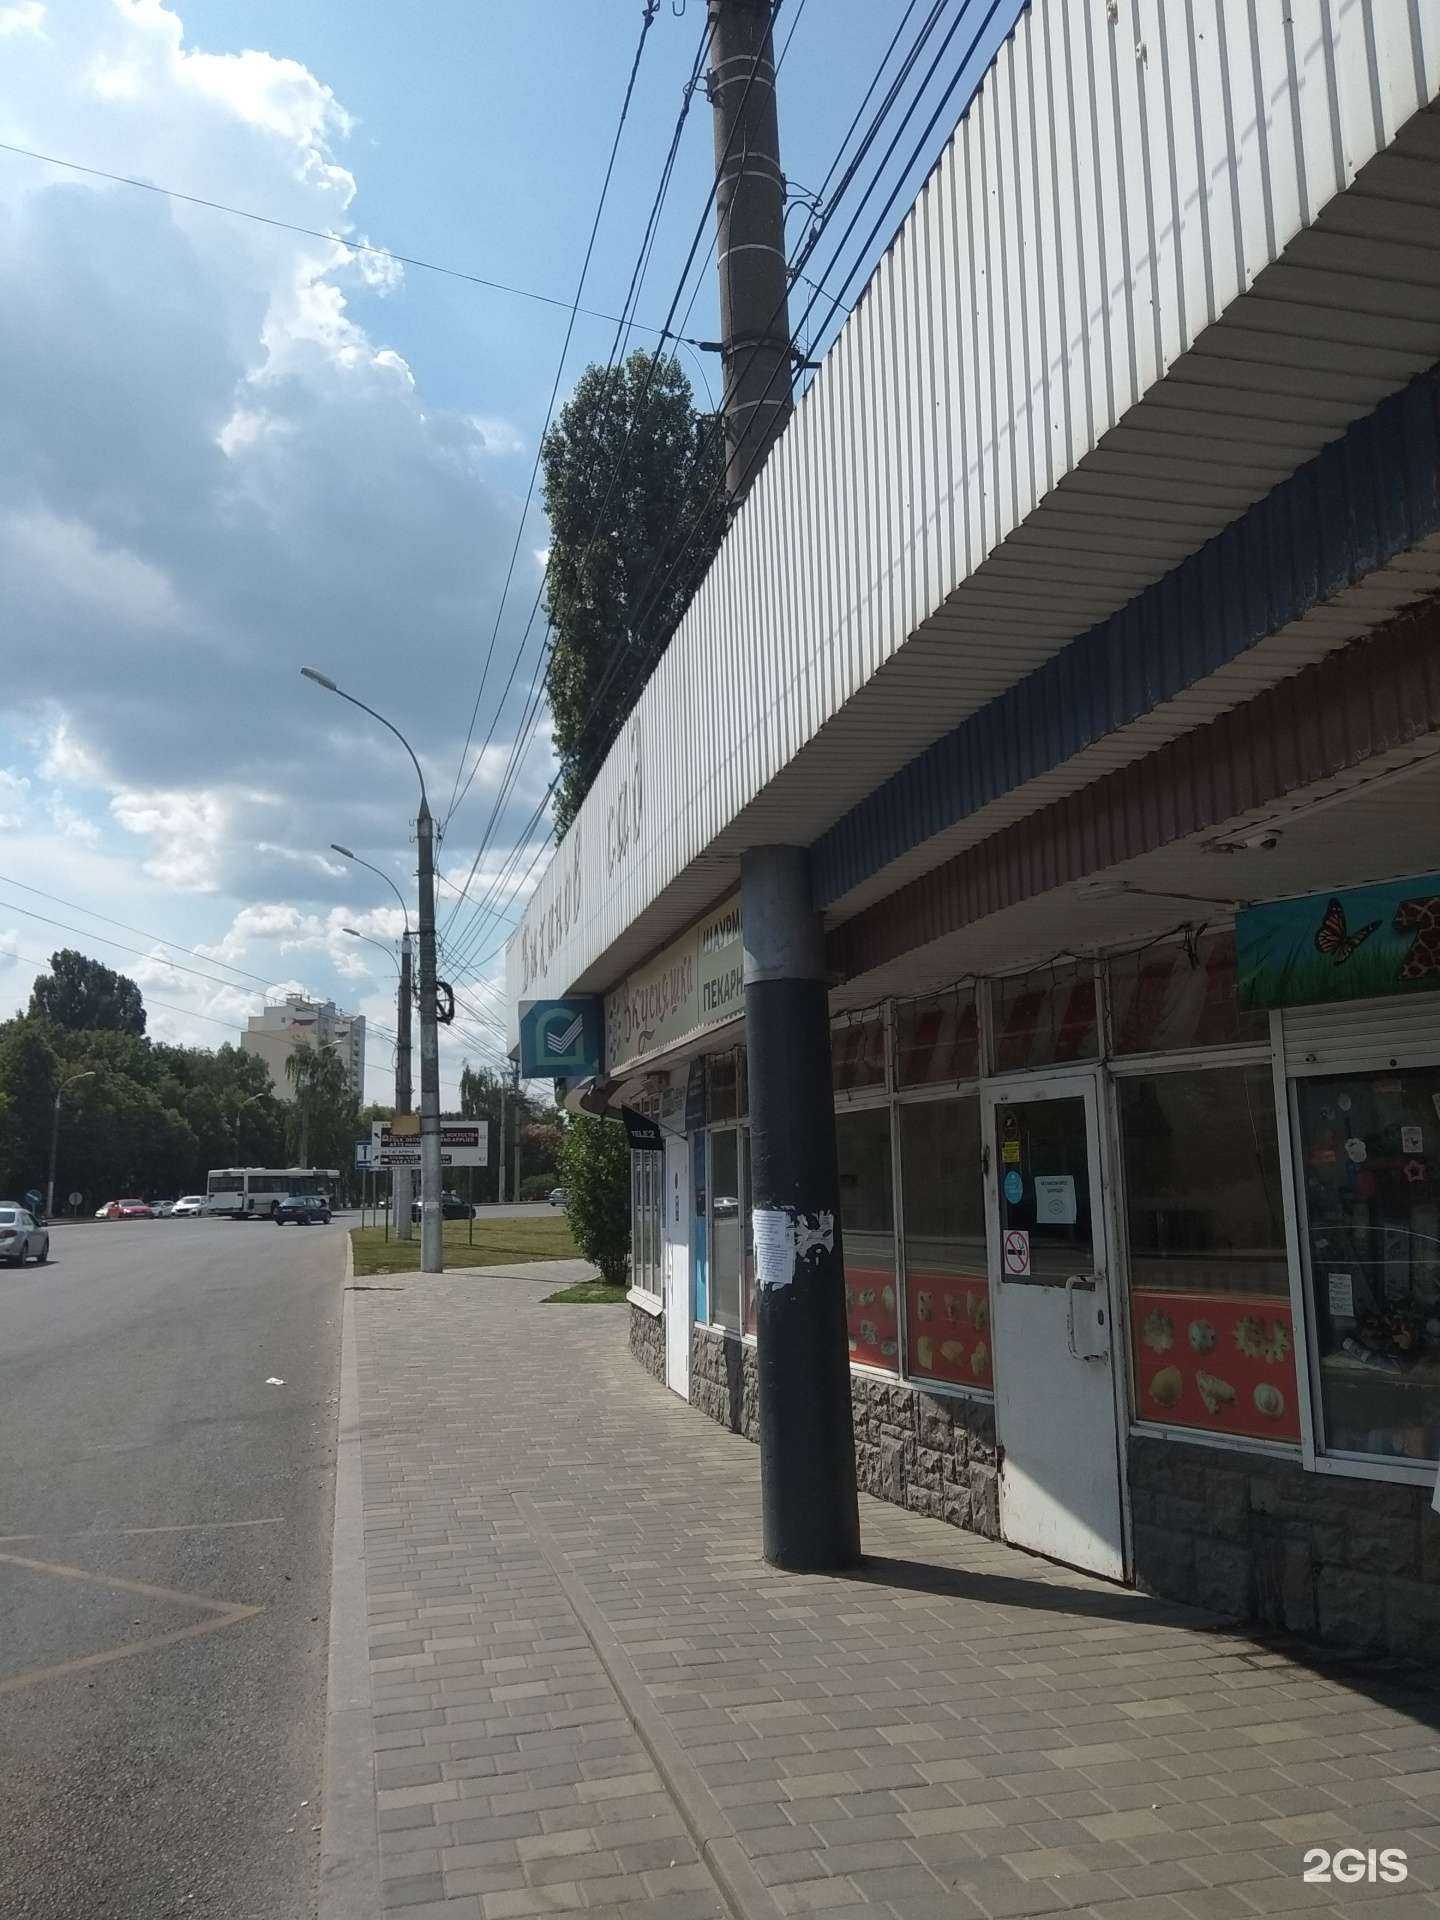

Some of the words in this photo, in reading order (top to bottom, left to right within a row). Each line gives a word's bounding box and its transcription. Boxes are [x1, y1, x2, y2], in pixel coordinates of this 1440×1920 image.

[607, 715, 643, 878] сад
[703, 908, 744, 953] ШАУРМ
[703, 964, 745, 1012] ПЕКАРН
